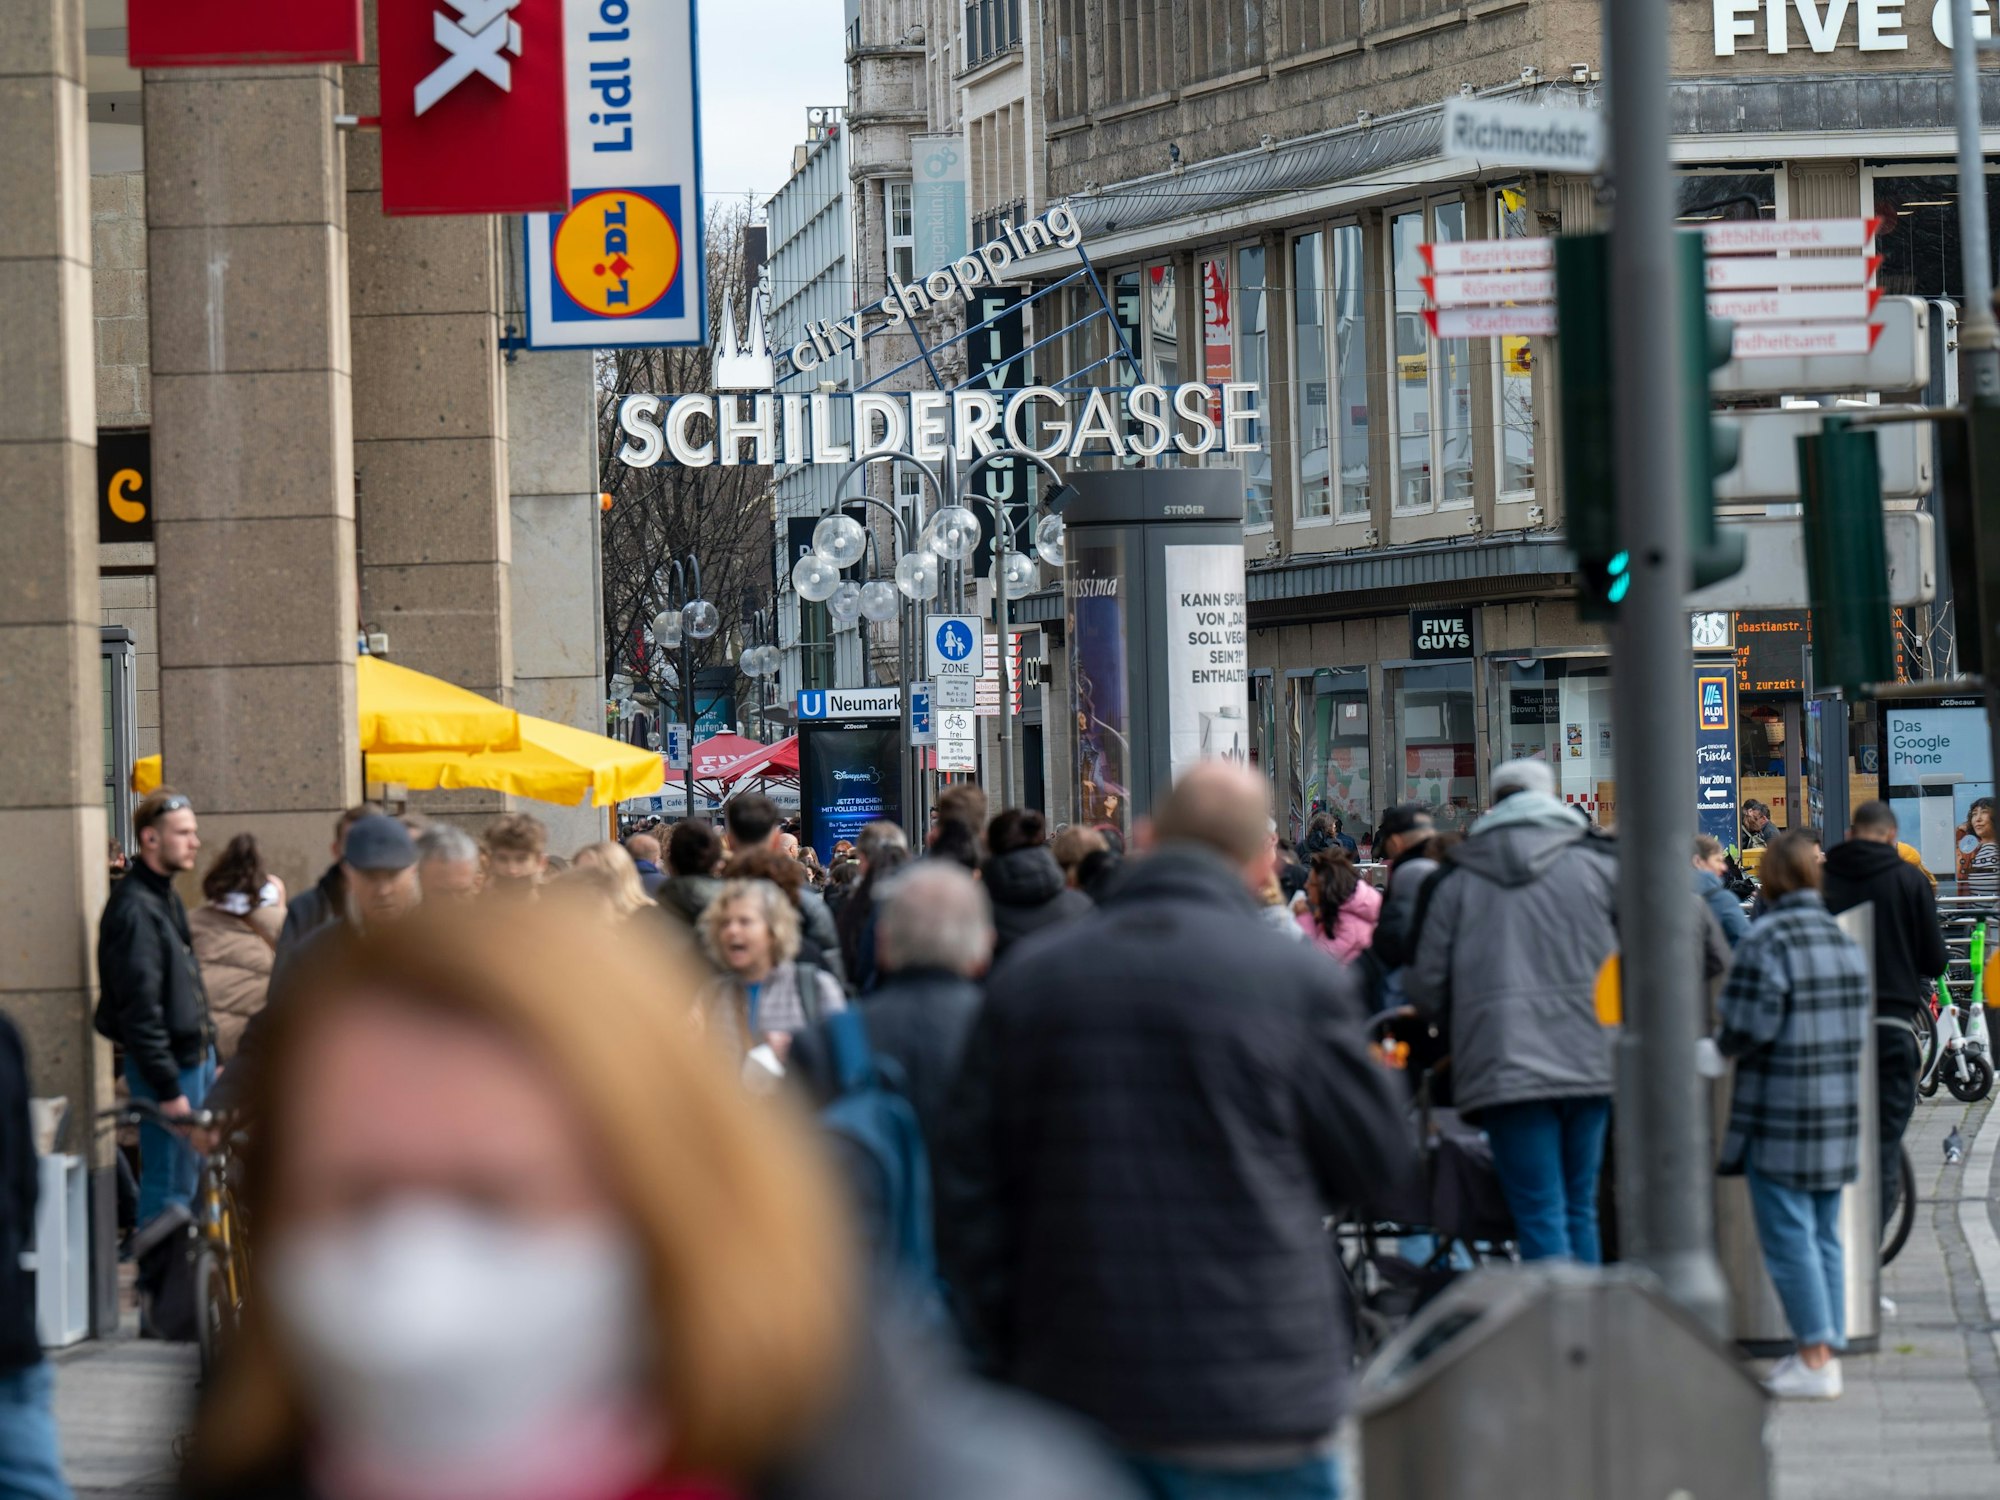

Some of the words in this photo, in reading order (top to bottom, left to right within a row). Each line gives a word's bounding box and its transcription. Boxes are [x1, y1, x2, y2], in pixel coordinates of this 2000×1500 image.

[1713, 0, 1909, 56] FIVE
[588, 57, 633, 153] Lidl
[790, 312, 863, 372] city
[881, 202, 1083, 327] shopping
[1465, 311, 1559, 330] Stadtmus
[618, 382, 1263, 469] SCHILDERGASSE
[1163, 504, 1205, 515] STRÖER
[1181, 593, 1221, 607] KANN
[1224, 593, 1246, 606] SPUR
[1196, 612, 1225, 626] VON
[1422, 619, 1464, 635] FIVE
[1735, 621, 1804, 633] ebastianstr.
[1188, 631, 1222, 645] SOLL
[1417, 634, 1470, 650] GUYS
[941, 663, 969, 673] ZONE
[1756, 679, 1796, 691] zurzeit
[802, 694, 821, 717] U
[1511, 705, 1537, 714] Brown
[1704, 707, 1723, 717] ALDI
[1893, 719, 1922, 733] Das
[1893, 735, 1951, 751] Google
[1696, 745, 1732, 764] Frische
[1895, 752, 1942, 765] Phone
[1699, 776, 1712, 785] Nur
[1712, 775, 1725, 784] 200
[666, 798, 682, 807] Café
[783, 796, 800, 804] Ries
[836, 798, 855, 806] JETZT
[855, 797, 883, 805] BUCHEN
[834, 805, 858, 813] VOLLER
